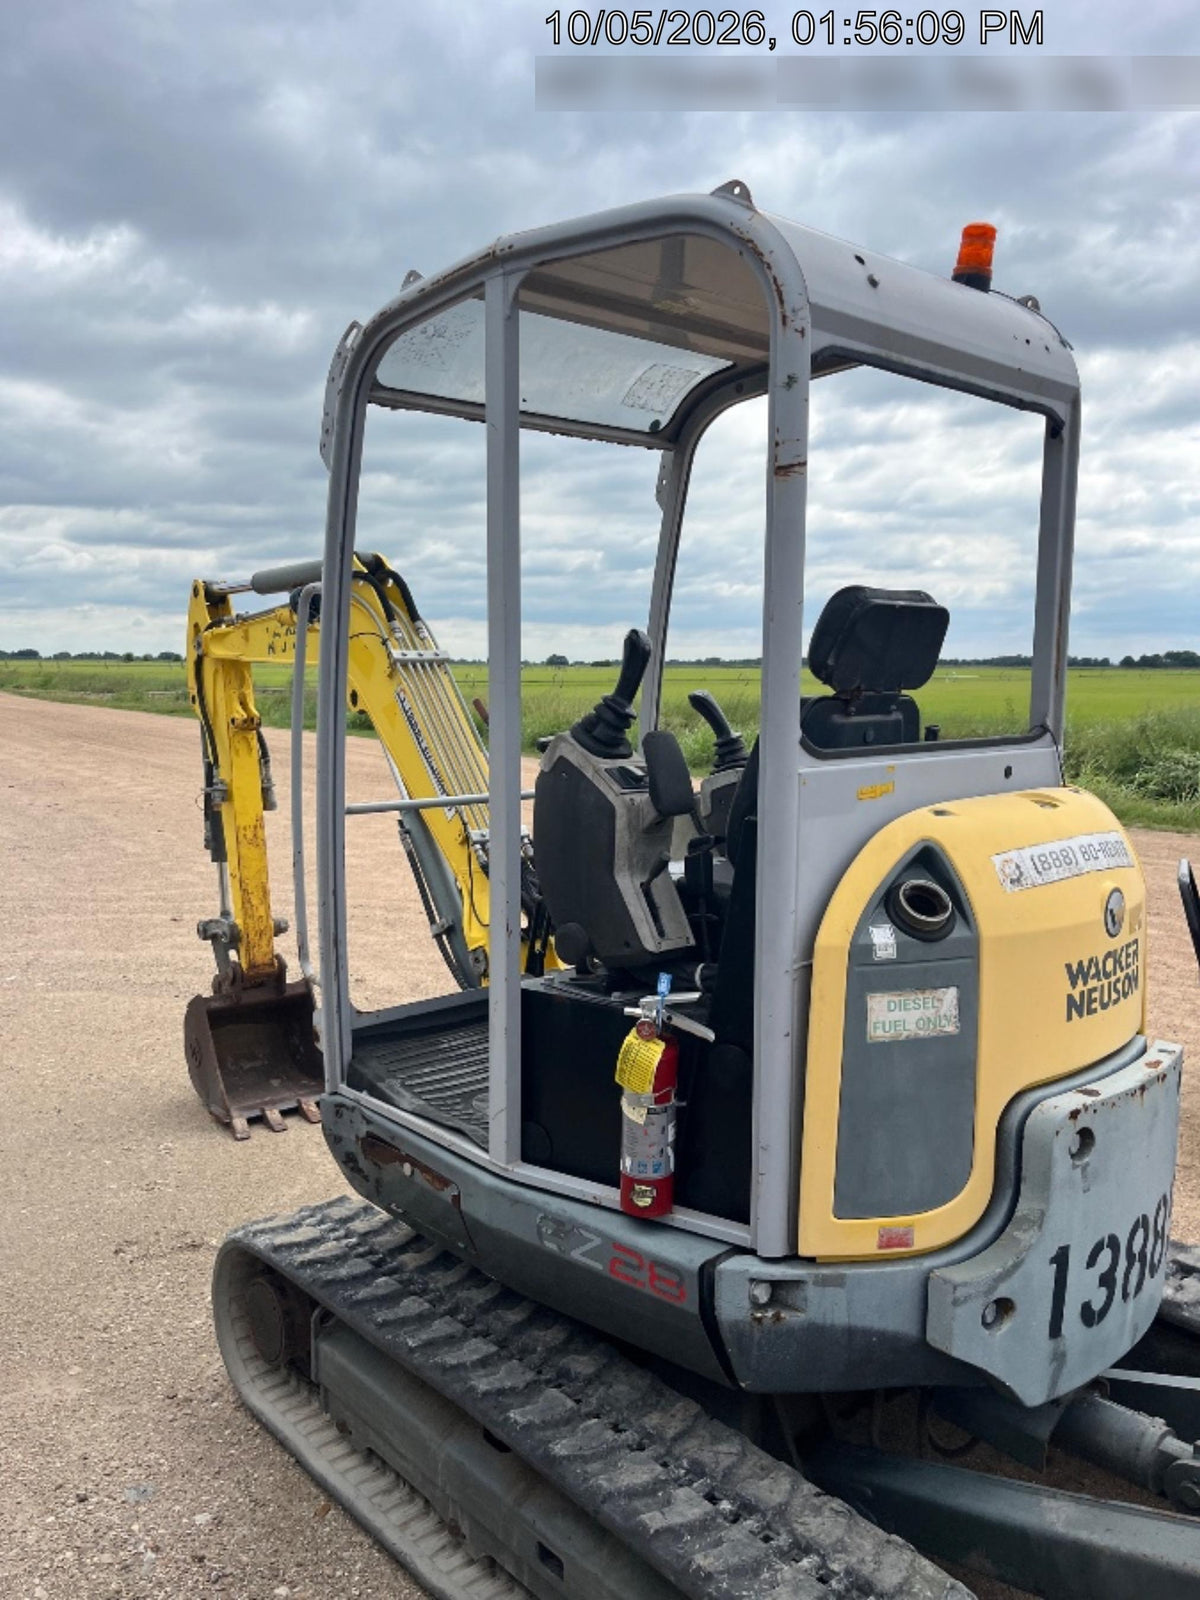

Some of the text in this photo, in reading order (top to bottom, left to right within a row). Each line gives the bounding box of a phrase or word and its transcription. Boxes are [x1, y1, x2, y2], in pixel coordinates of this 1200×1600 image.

[1030, 845, 1079, 876] (888)
[1064, 938, 1138, 990] WACKER
[887, 995, 941, 1012] DIESEL
[1066, 965, 1138, 1023] NEUSON
[872, 1013, 953, 1034] FUEL ONLY
[1048, 1188, 1172, 1340] 1388
